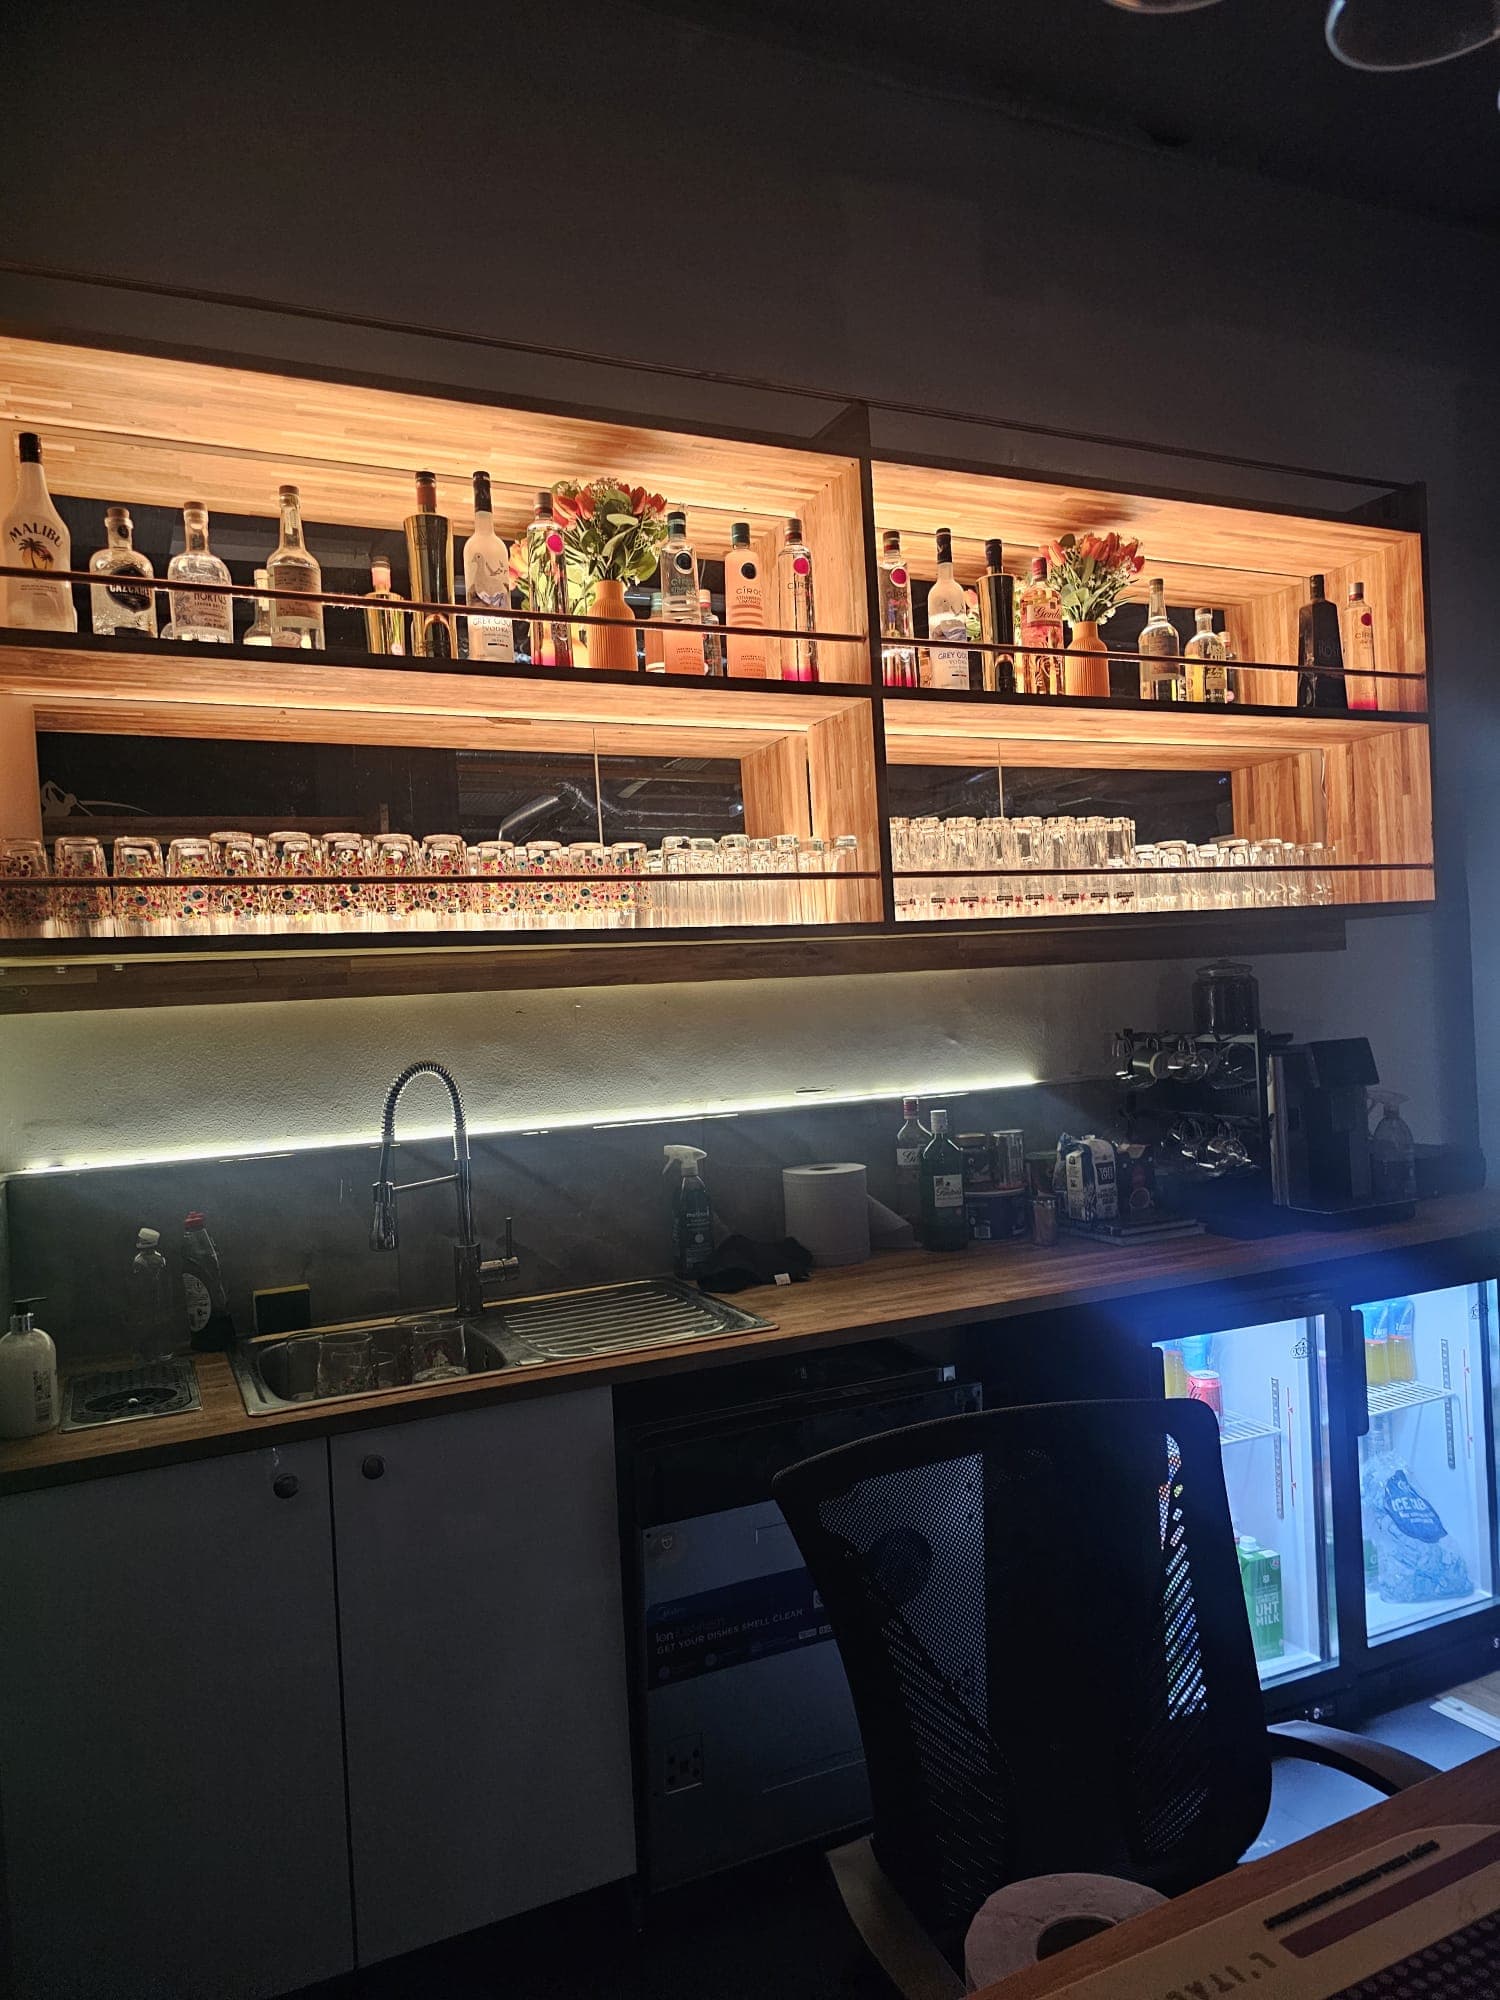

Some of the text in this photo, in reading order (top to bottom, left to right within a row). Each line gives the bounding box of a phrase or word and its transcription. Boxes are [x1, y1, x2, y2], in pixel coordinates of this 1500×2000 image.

[9, 522, 64, 548] MALIBU
[937, 651, 955, 660] GREY
[1391, 1497, 1411, 1512] ICE
[1255, 1600, 1280, 1617] UHT
[1255, 1613, 1280, 1627] MILK
[679, 1635, 705, 1650] YOUR
[707, 1624, 739, 1641] DISHES
[772, 1608, 803, 1623] CLEAN
